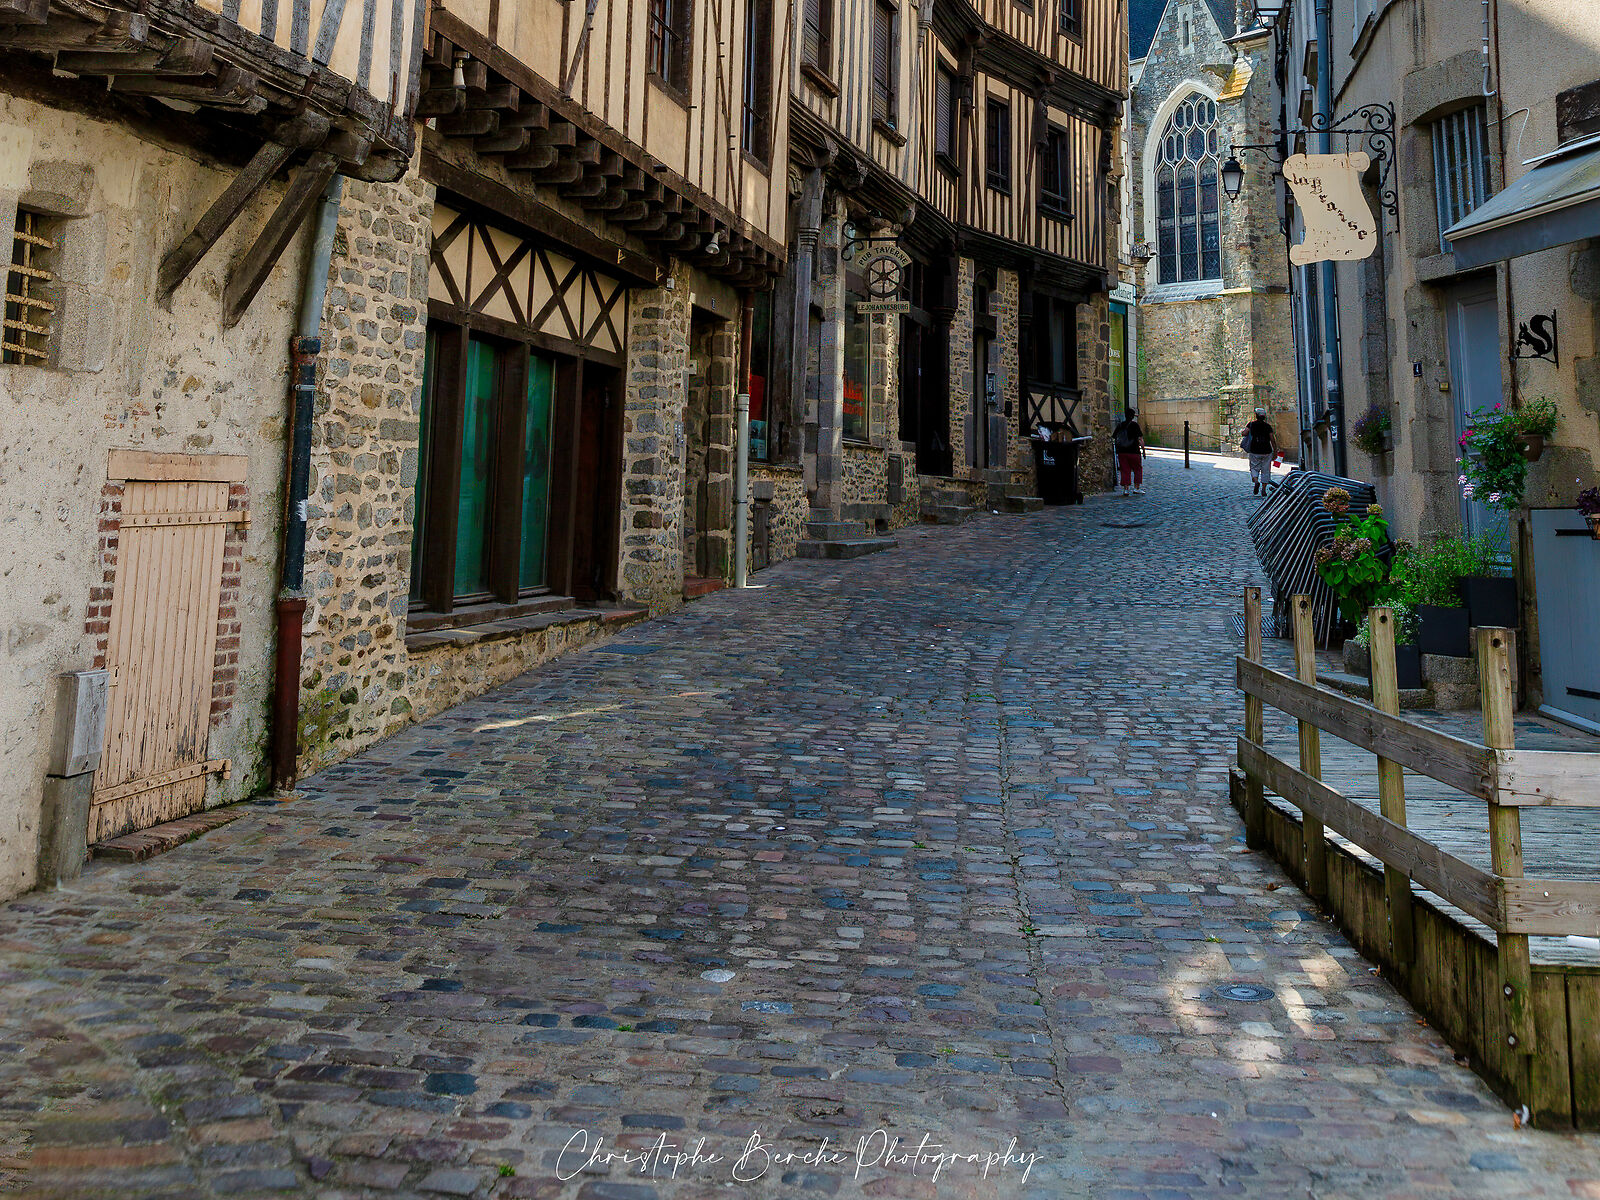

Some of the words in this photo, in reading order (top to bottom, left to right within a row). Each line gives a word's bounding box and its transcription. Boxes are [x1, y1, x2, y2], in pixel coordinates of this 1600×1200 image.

[858, 251, 872, 266] PUB
[874, 246, 908, 265] TAVERNE
[865, 303, 909, 311] JOHANNESBURG
